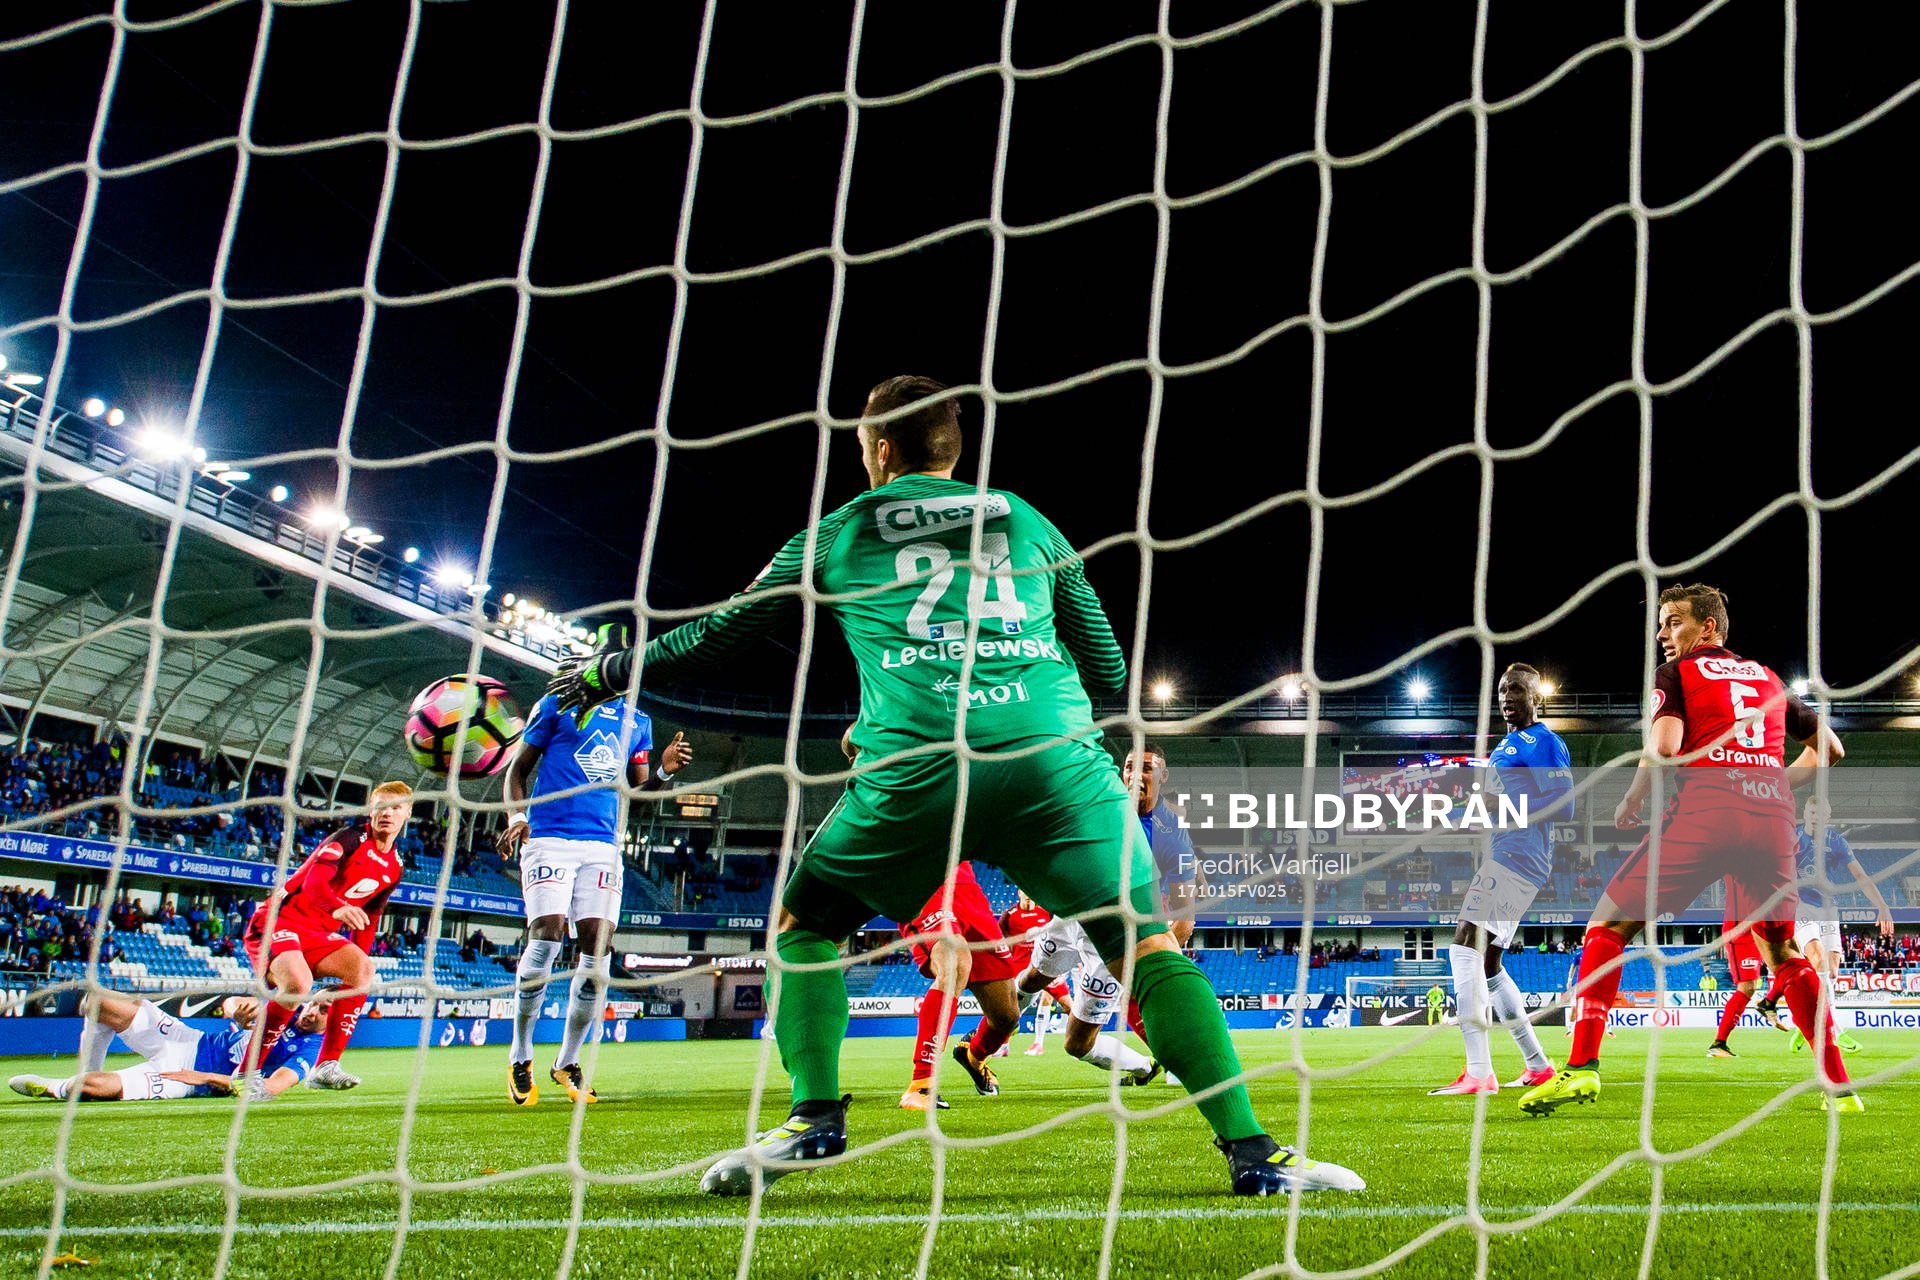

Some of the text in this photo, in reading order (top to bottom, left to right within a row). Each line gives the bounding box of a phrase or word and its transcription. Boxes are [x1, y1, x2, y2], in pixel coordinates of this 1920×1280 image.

[885, 501, 988, 532] Ches
[895, 532, 1028, 640] 24
[1703, 661, 1757, 676] Chess
[1730, 681, 1766, 748] 5
[631, 914, 662, 925] ISTAD
[1237, 915, 1272, 925] ISTAD
[1338, 915, 1373, 925] ISTAD
[1440, 914, 1459, 924] IST
[1540, 914, 1574, 923] ISTAD
[1842, 911, 1876, 921] ISTAD
[728, 918, 764, 928] ISTAD
[1083, 973, 1117, 995] BDO
[1688, 992, 1737, 1007] HAMS
[1653, 1009, 1680, 1027] Oil
